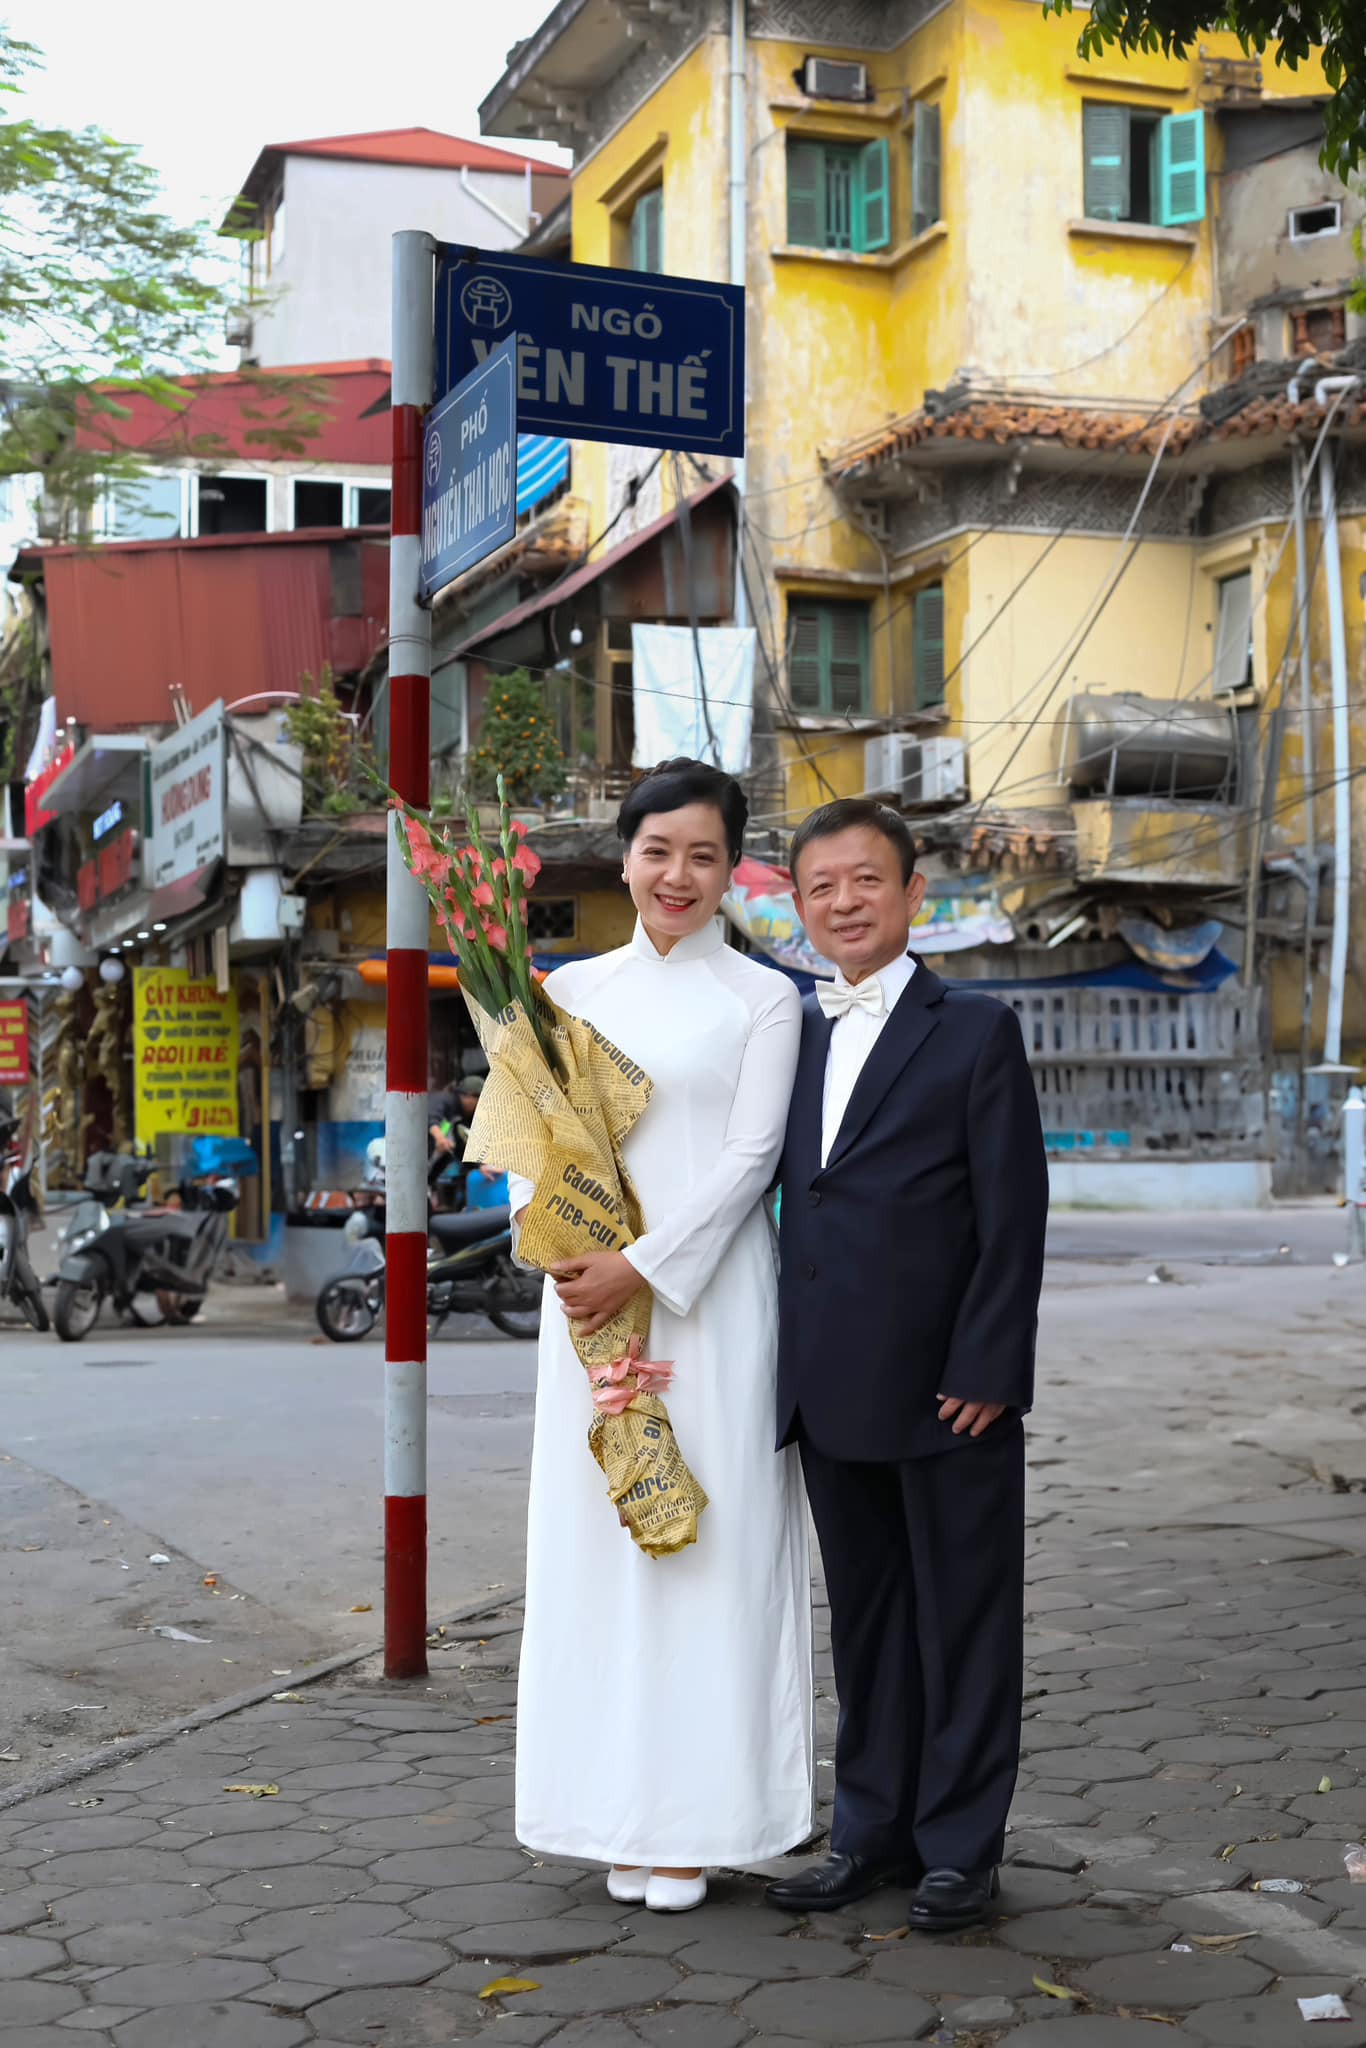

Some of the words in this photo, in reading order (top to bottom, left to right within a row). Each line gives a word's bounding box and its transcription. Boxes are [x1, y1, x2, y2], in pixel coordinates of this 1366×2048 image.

[571, 303, 663, 339] NGÕ
[606, 349, 712, 420] THẾ
[461, 388, 488, 451] PHỐ
[463, 451, 487, 535] THÁI
[488, 440, 510, 523] HỌC
[545, 1194, 618, 1248] rice-cut
